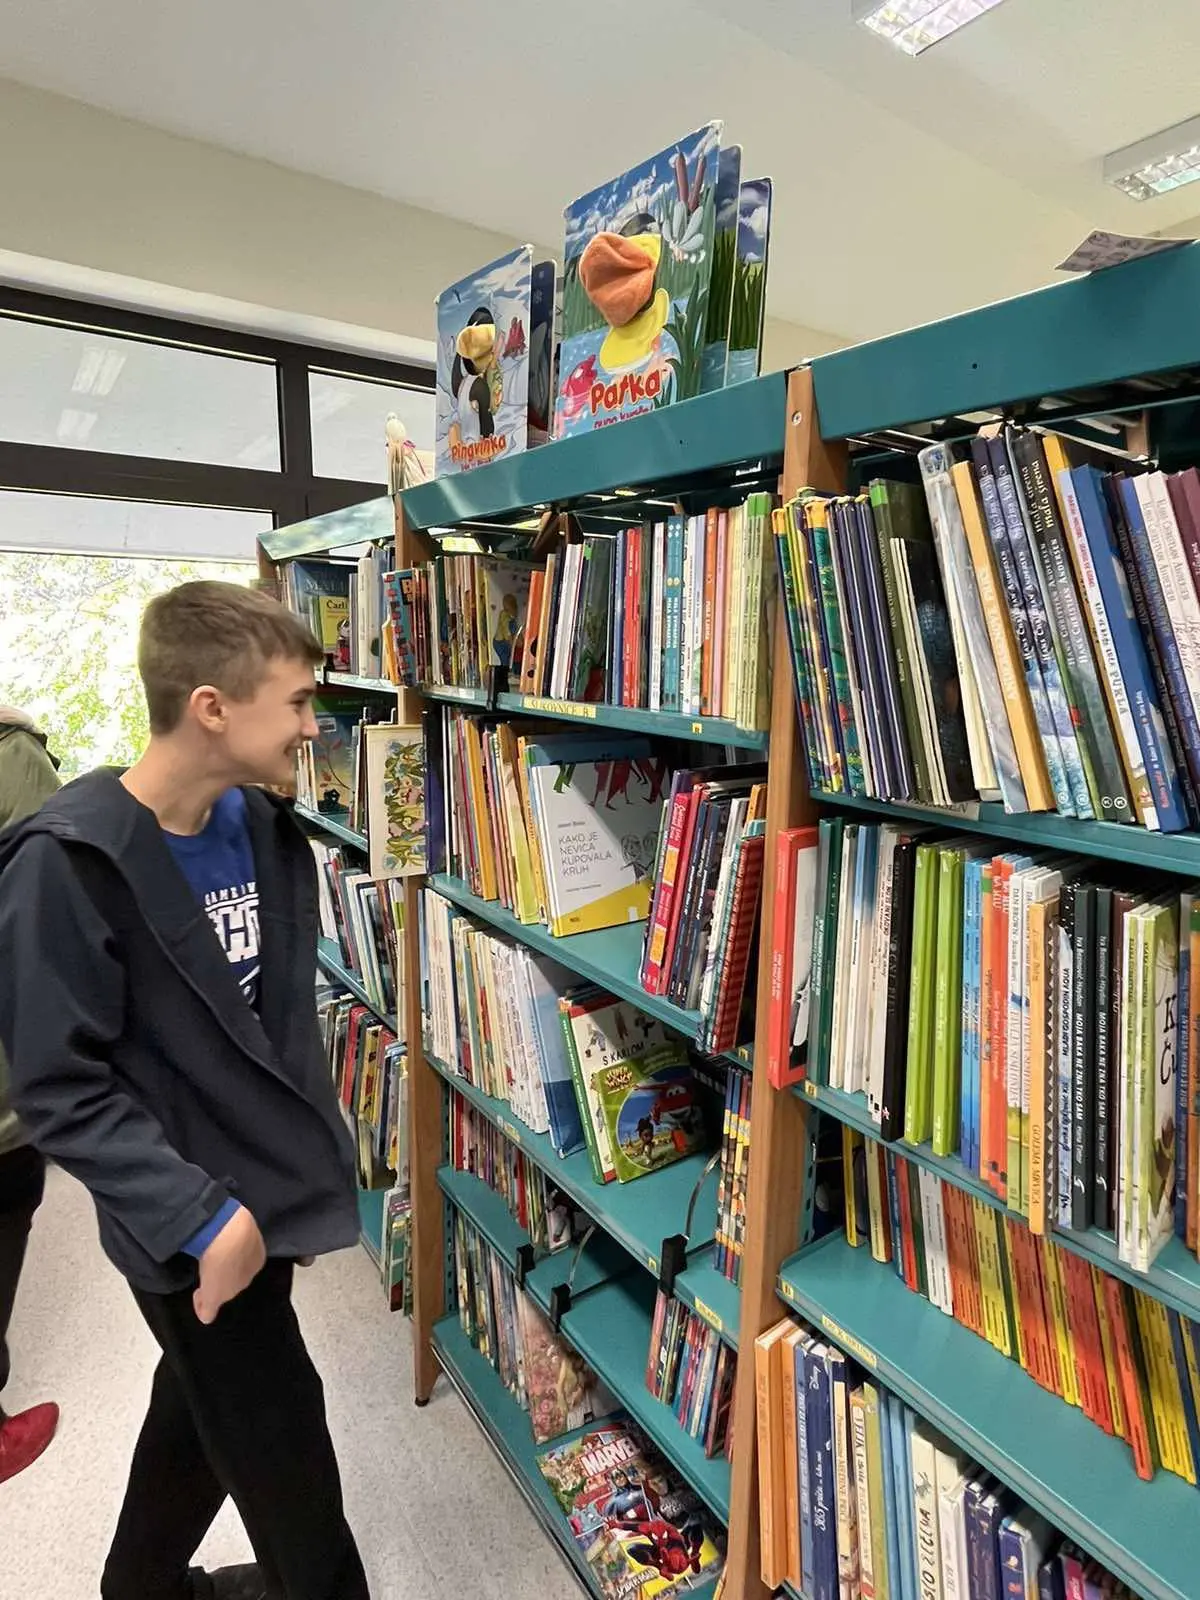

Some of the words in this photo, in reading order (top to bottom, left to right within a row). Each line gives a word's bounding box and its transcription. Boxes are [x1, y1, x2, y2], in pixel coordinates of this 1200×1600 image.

[558, 833, 586, 844] KAKO
[589, 831, 600, 841] JE
[561, 850, 612, 866] KUPOVALA
[563, 865, 589, 877] KRUH
[1061, 991, 1069, 1031] GOSPODIN
[1098, 1011, 1106, 1033] MOJA
[611, 1041, 645, 1062] KARLOM
[1098, 1034, 1106, 1055] BAKA
[1076, 1057, 1082, 1068] NE
[1099, 1056, 1105, 1067] NE
[1032, 1124, 1040, 1165] GOLEMA
[813, 1505, 825, 1531] 365
